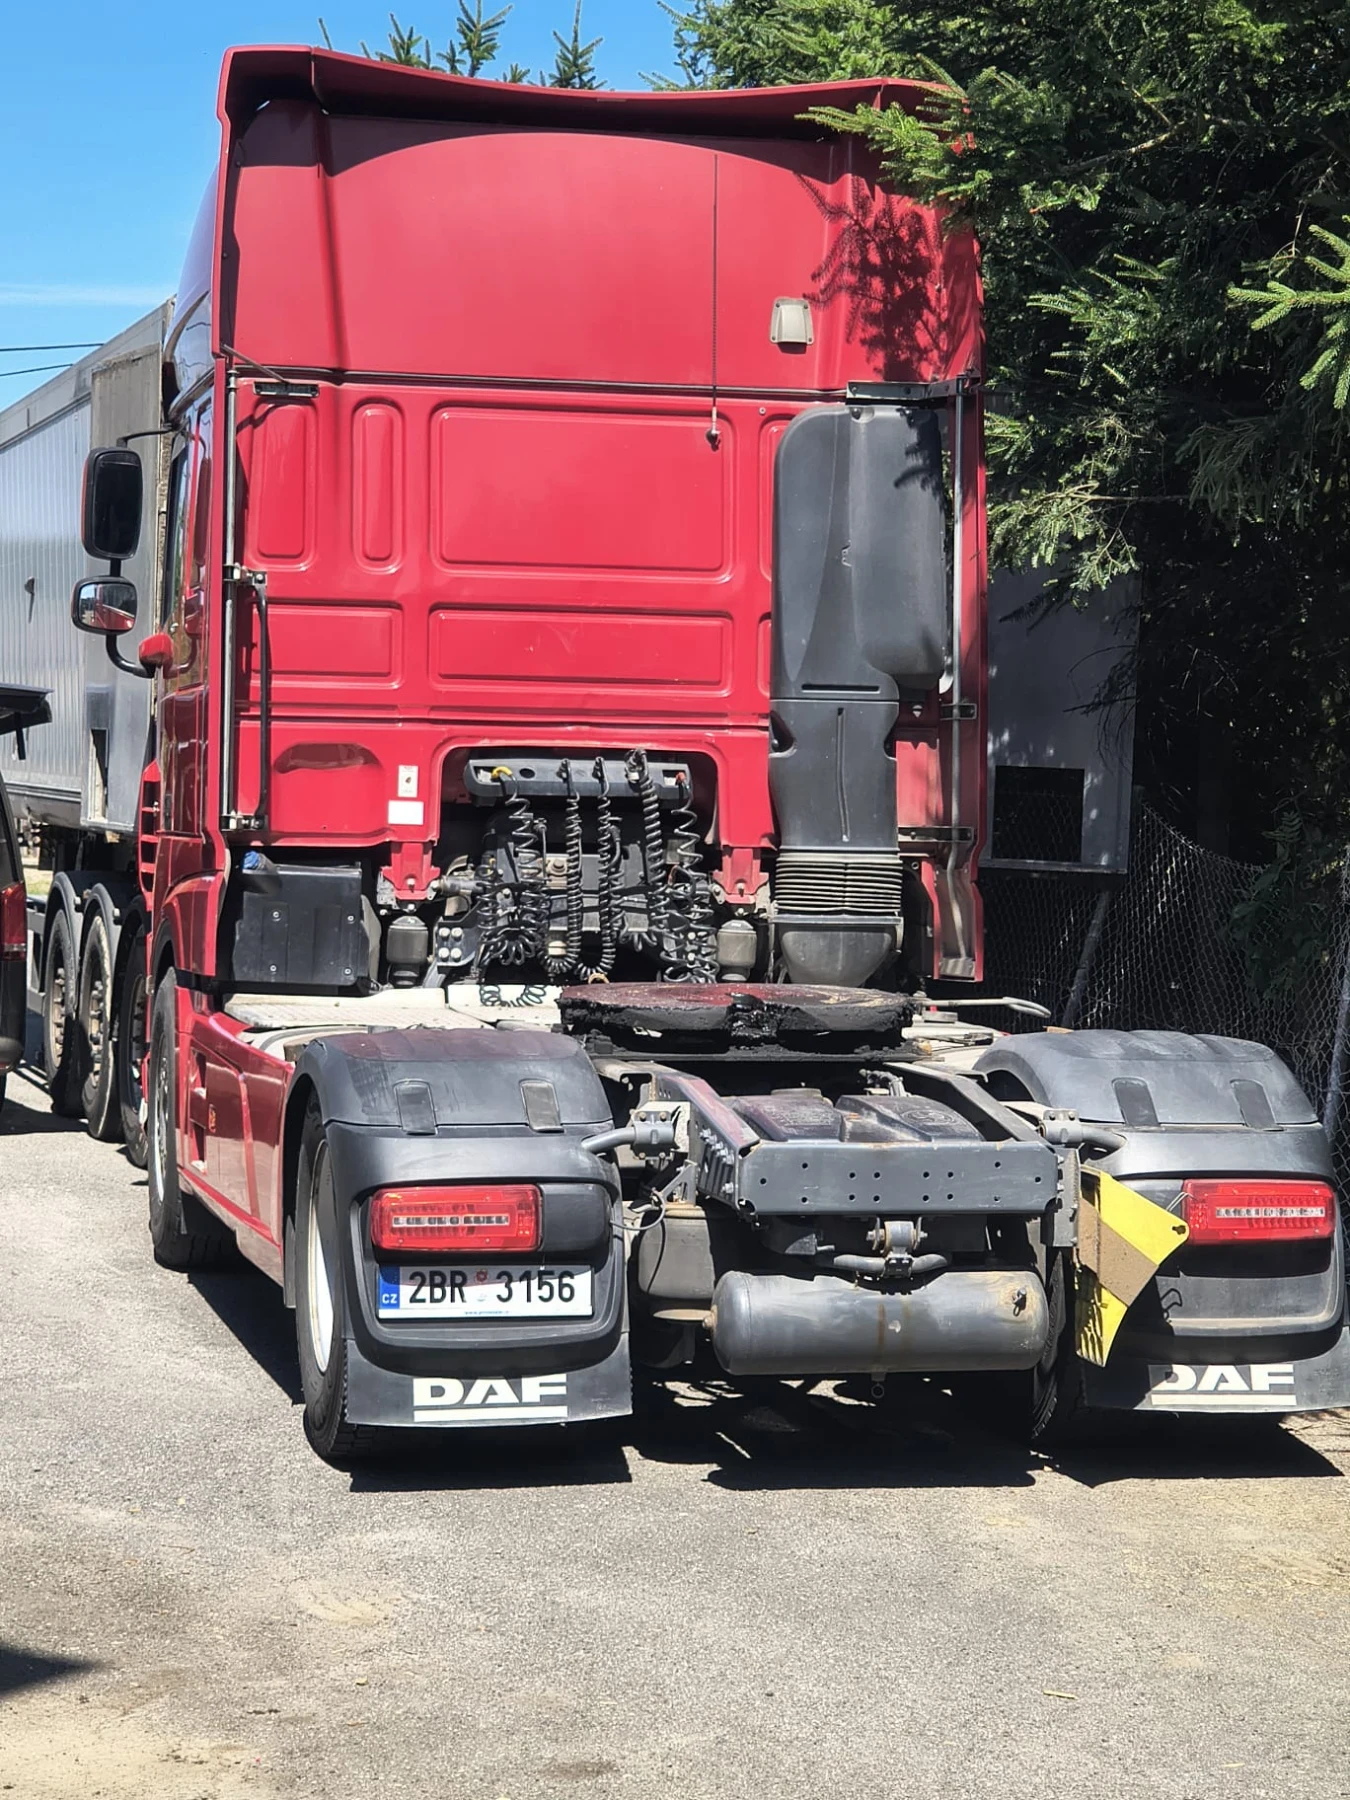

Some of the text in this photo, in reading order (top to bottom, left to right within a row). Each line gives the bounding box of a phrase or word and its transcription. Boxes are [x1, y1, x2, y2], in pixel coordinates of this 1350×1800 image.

[382, 1293, 398, 1304] CZ
[409, 1270, 575, 1304] 2BR 3156
[413, 1374, 567, 1406] DAF
[1150, 1364, 1295, 1391] DAF
